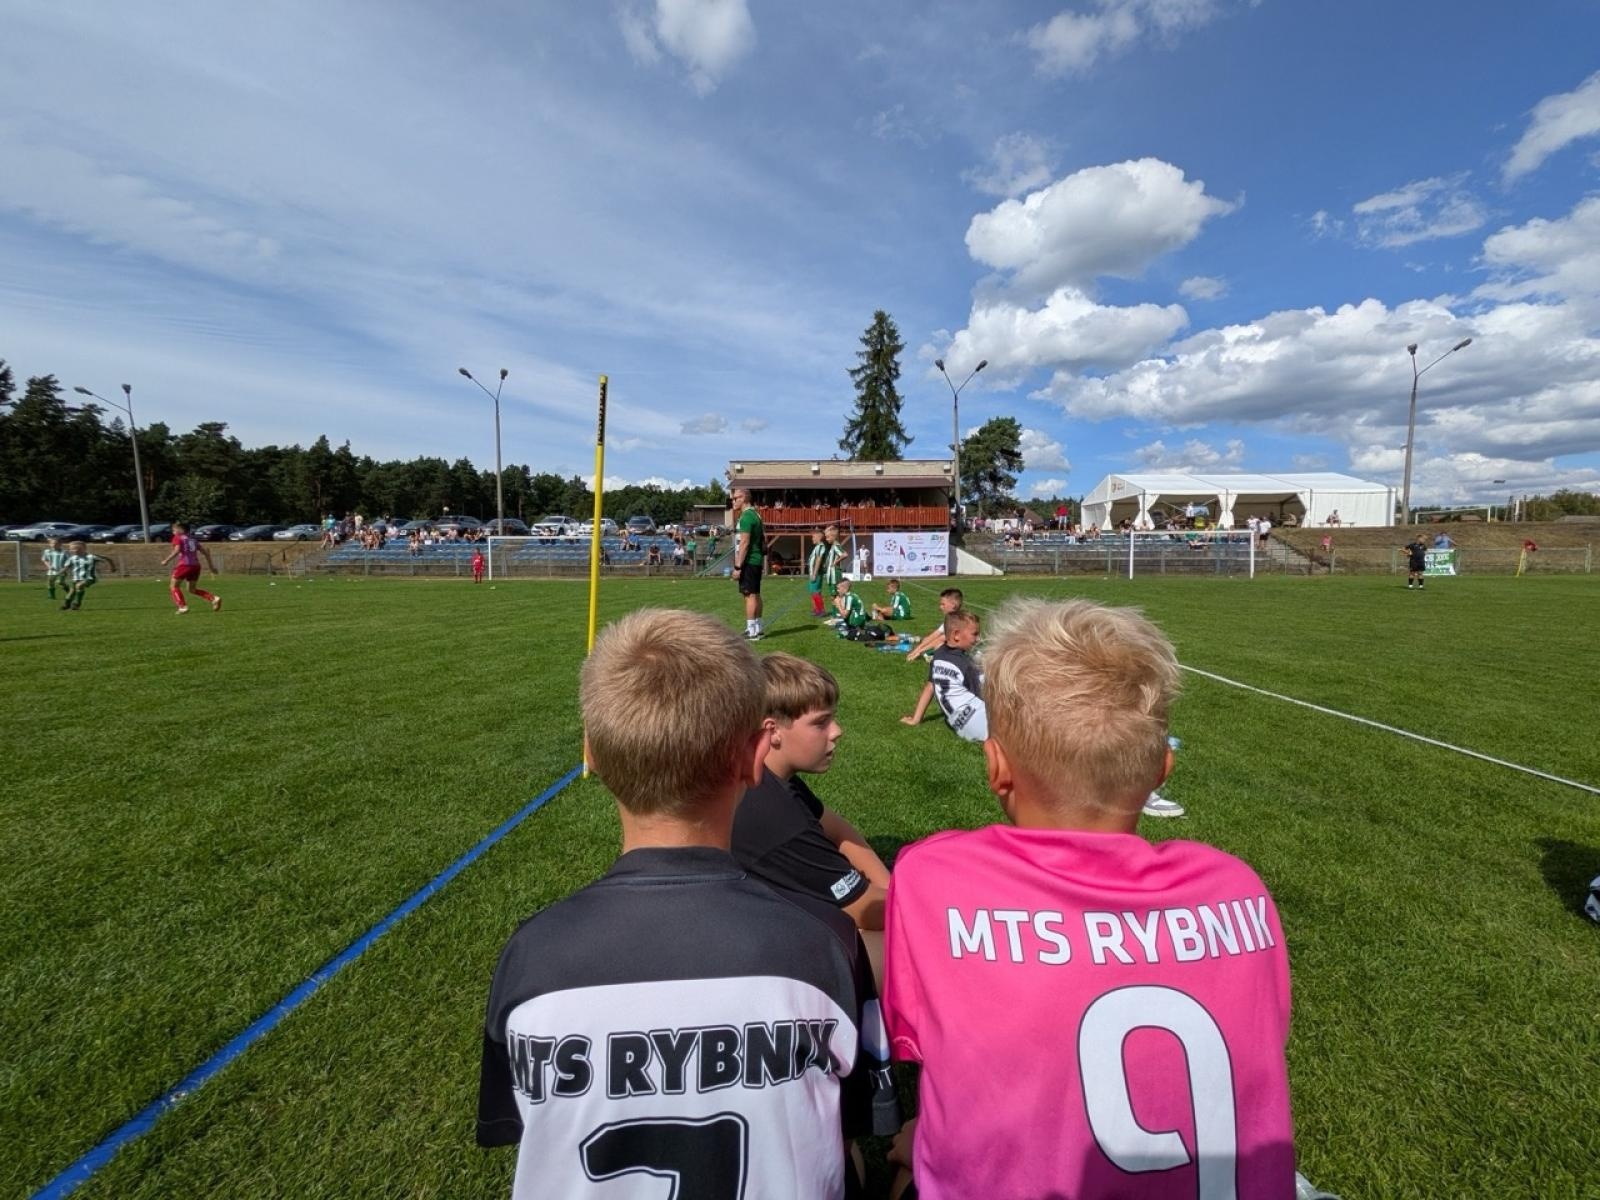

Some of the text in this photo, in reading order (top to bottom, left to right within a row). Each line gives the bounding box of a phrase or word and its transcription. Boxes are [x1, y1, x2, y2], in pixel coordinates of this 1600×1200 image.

[947, 896, 1275, 965] MTS RYBNIK
[508, 1019, 842, 1104] MTS RYBNIK
[1077, 984, 1239, 1200] 9
